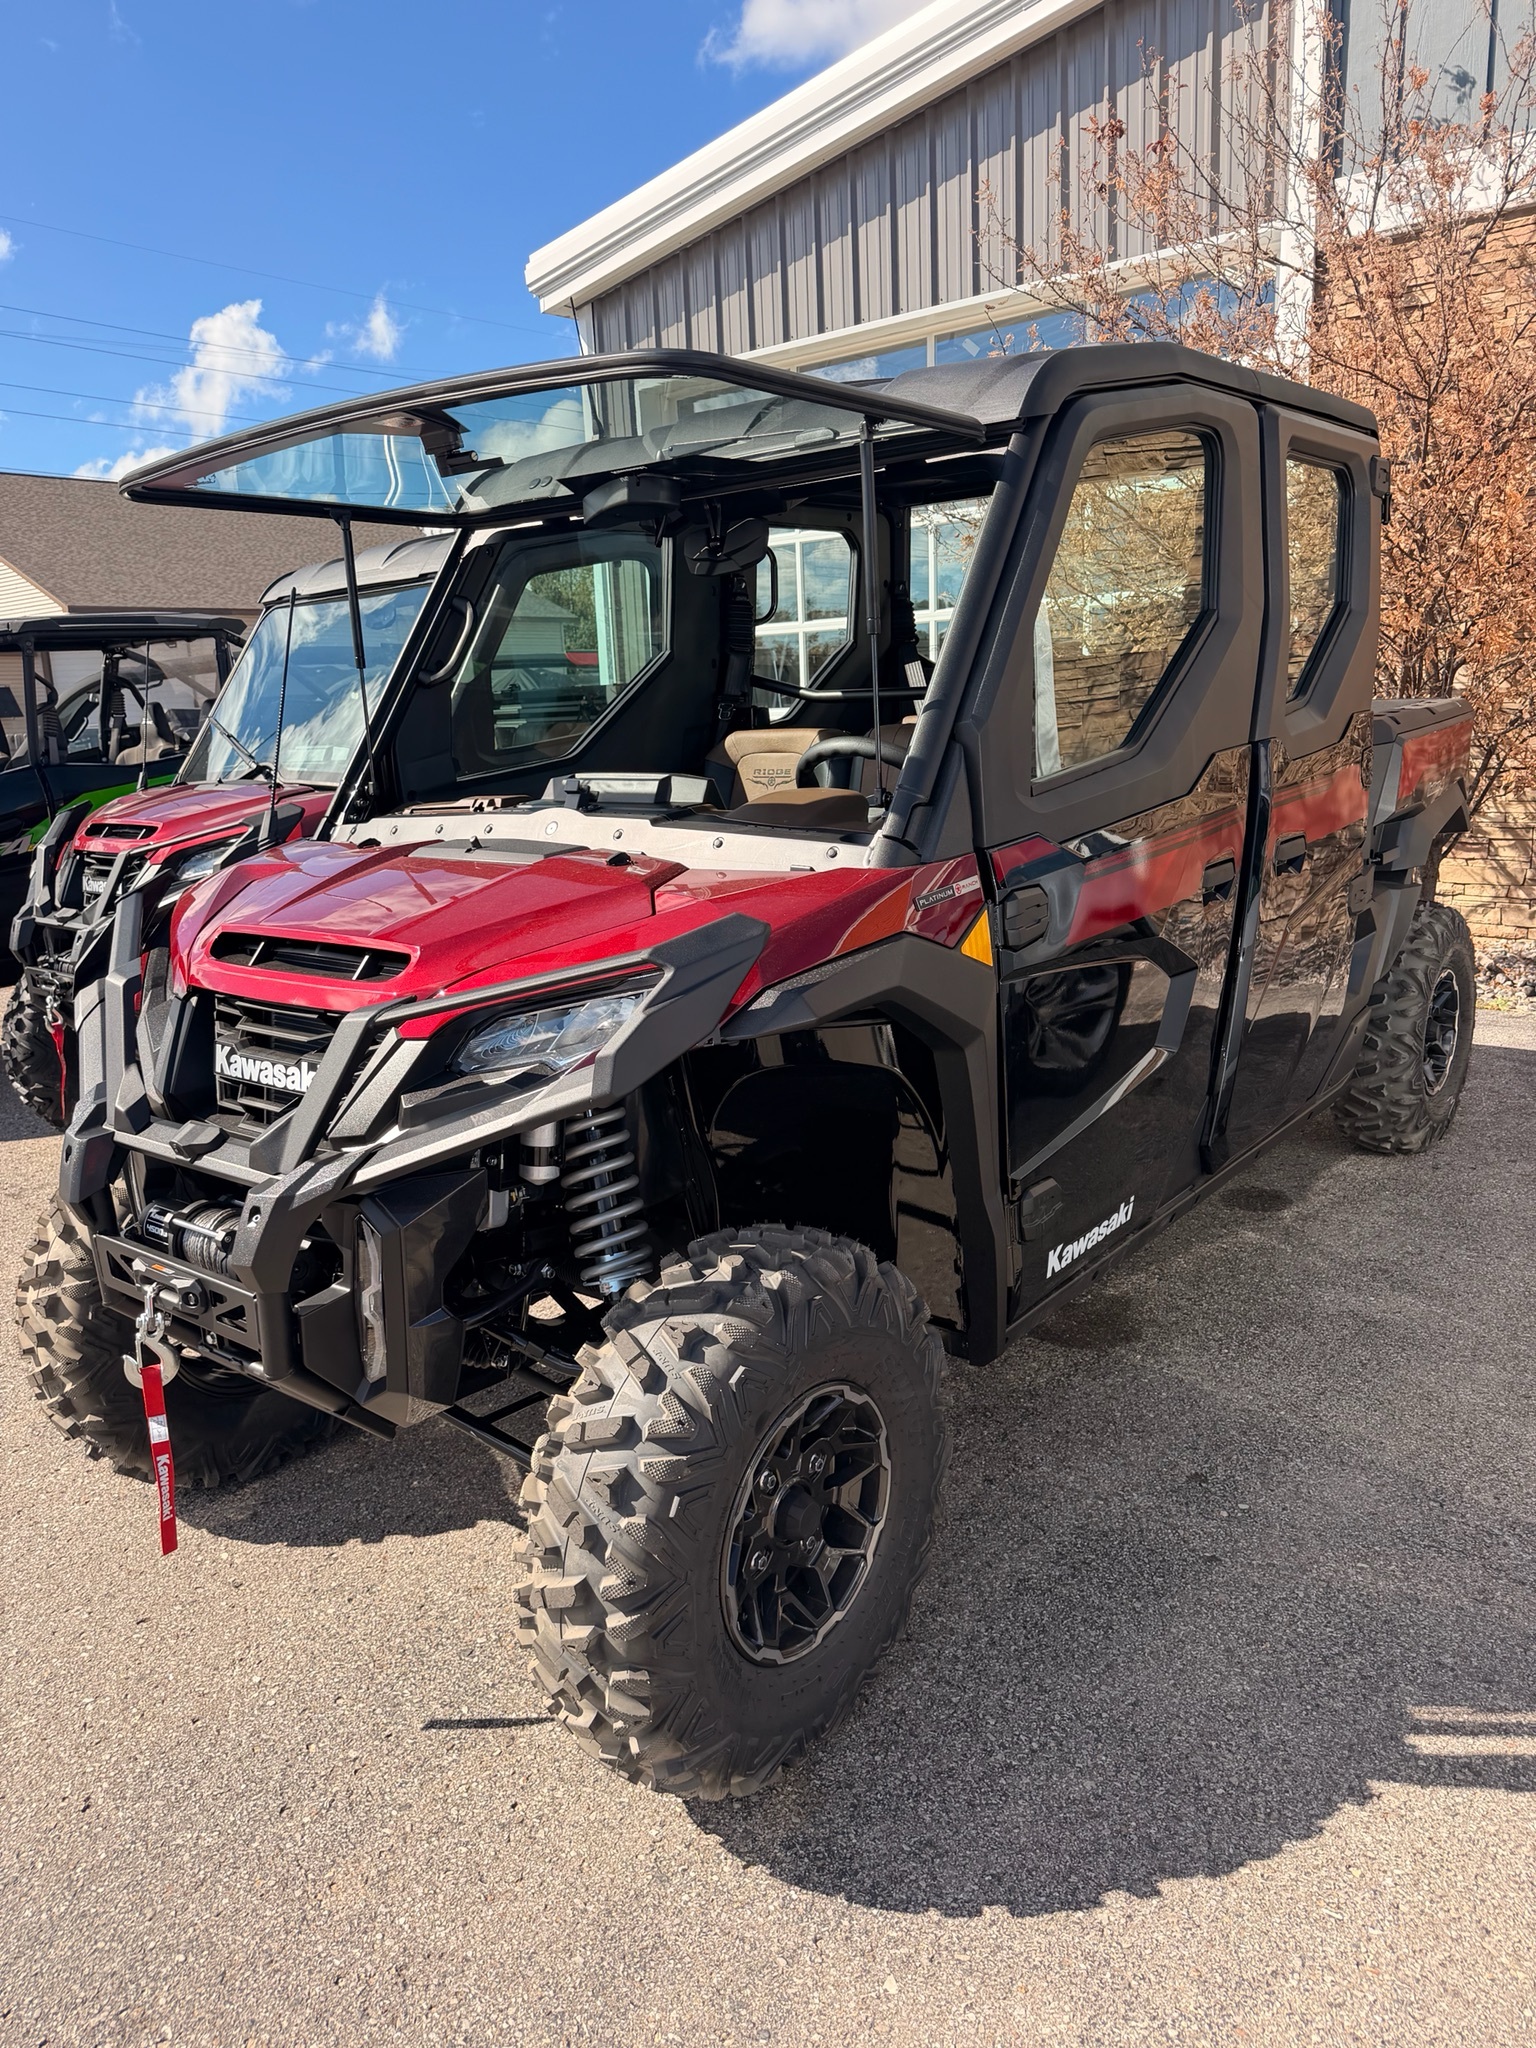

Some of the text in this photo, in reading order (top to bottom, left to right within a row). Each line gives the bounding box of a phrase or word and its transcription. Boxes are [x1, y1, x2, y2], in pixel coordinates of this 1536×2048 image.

[753, 768, 792, 776] RIDGE
[919, 889, 954, 907] PLATINUM
[215, 1043, 321, 1093] Kawasak
[1046, 1195, 1135, 1279] Kawasaki
[156, 1453, 173, 1522] Kawasaki
